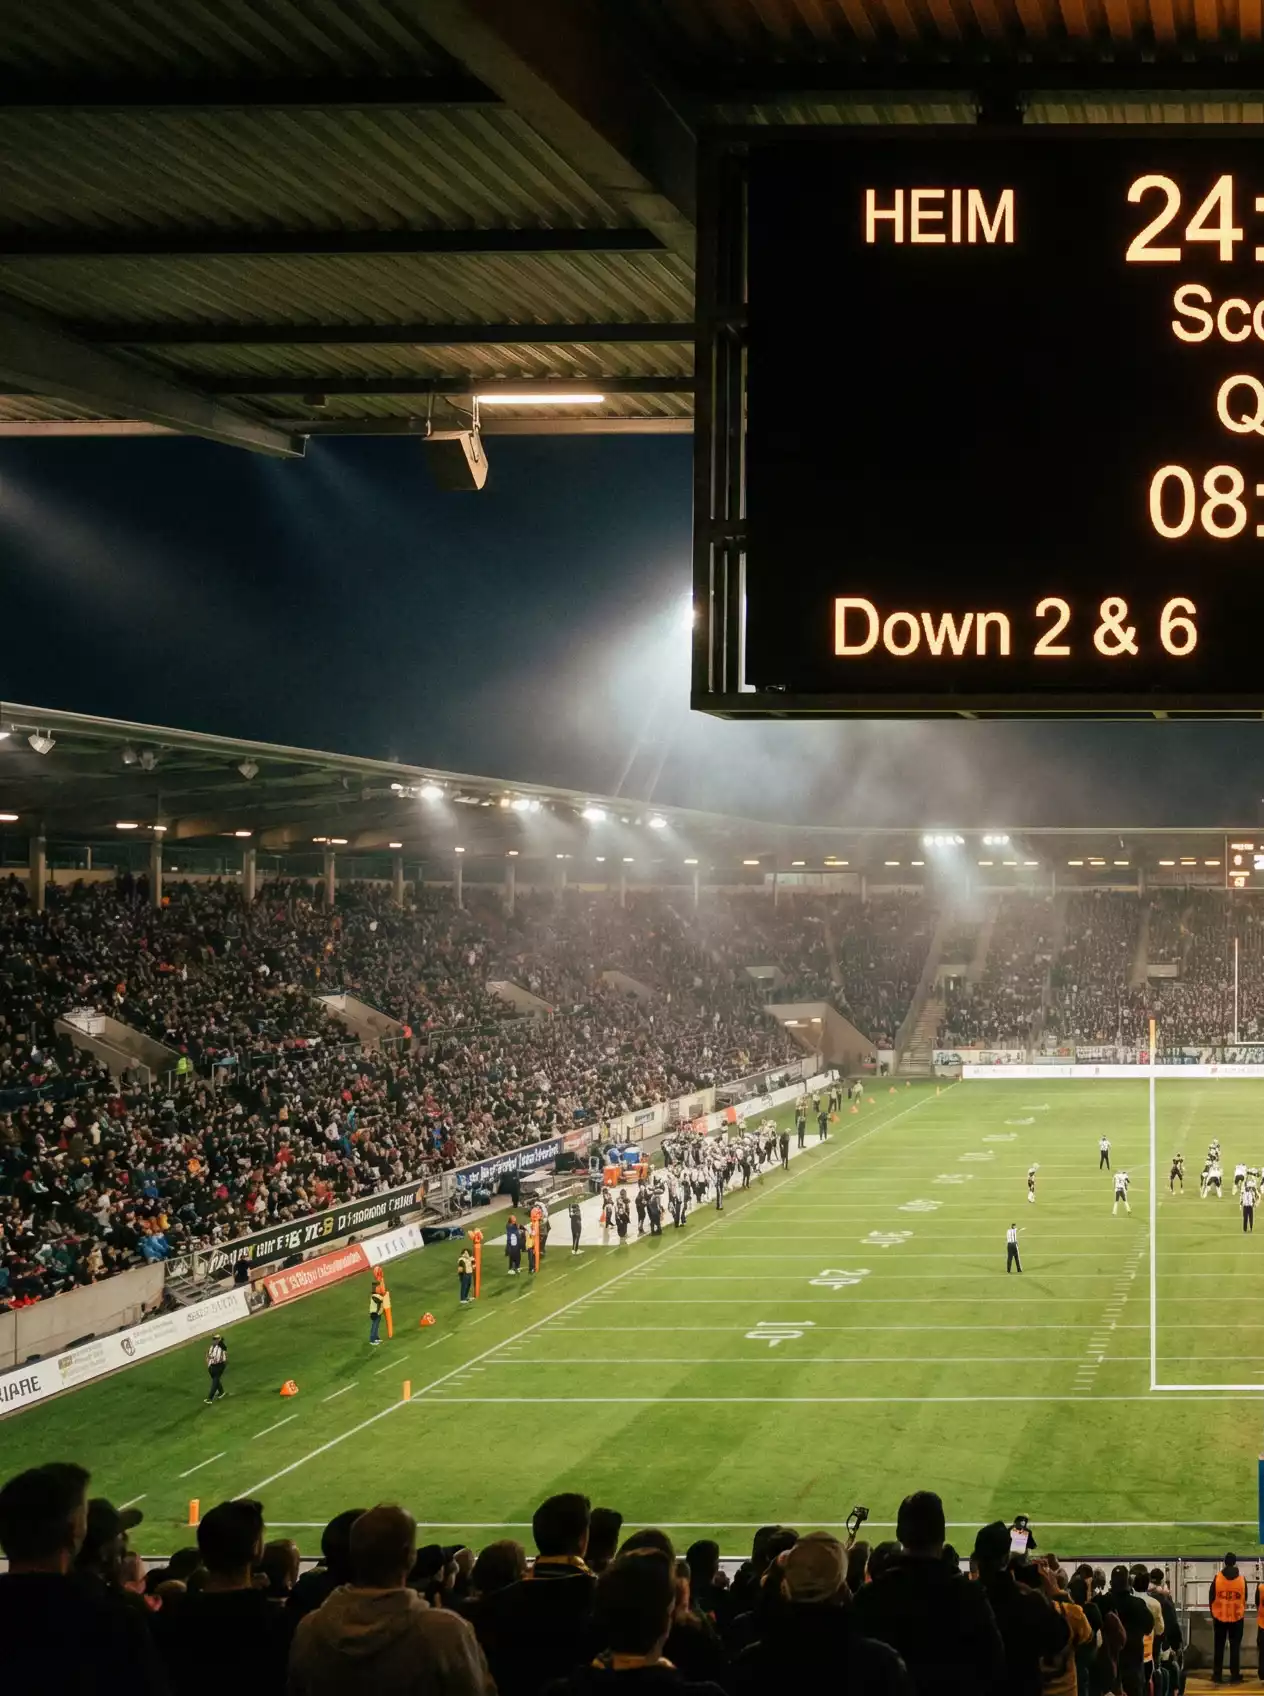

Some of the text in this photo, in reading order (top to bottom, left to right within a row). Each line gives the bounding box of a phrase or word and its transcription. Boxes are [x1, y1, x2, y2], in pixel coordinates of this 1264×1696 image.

[865, 188, 1015, 244] HEIM
[834, 596, 1198, 657] Down 2 & 6
[808, 1269, 872, 1286] 20
[744, 1320, 817, 1339] 10
